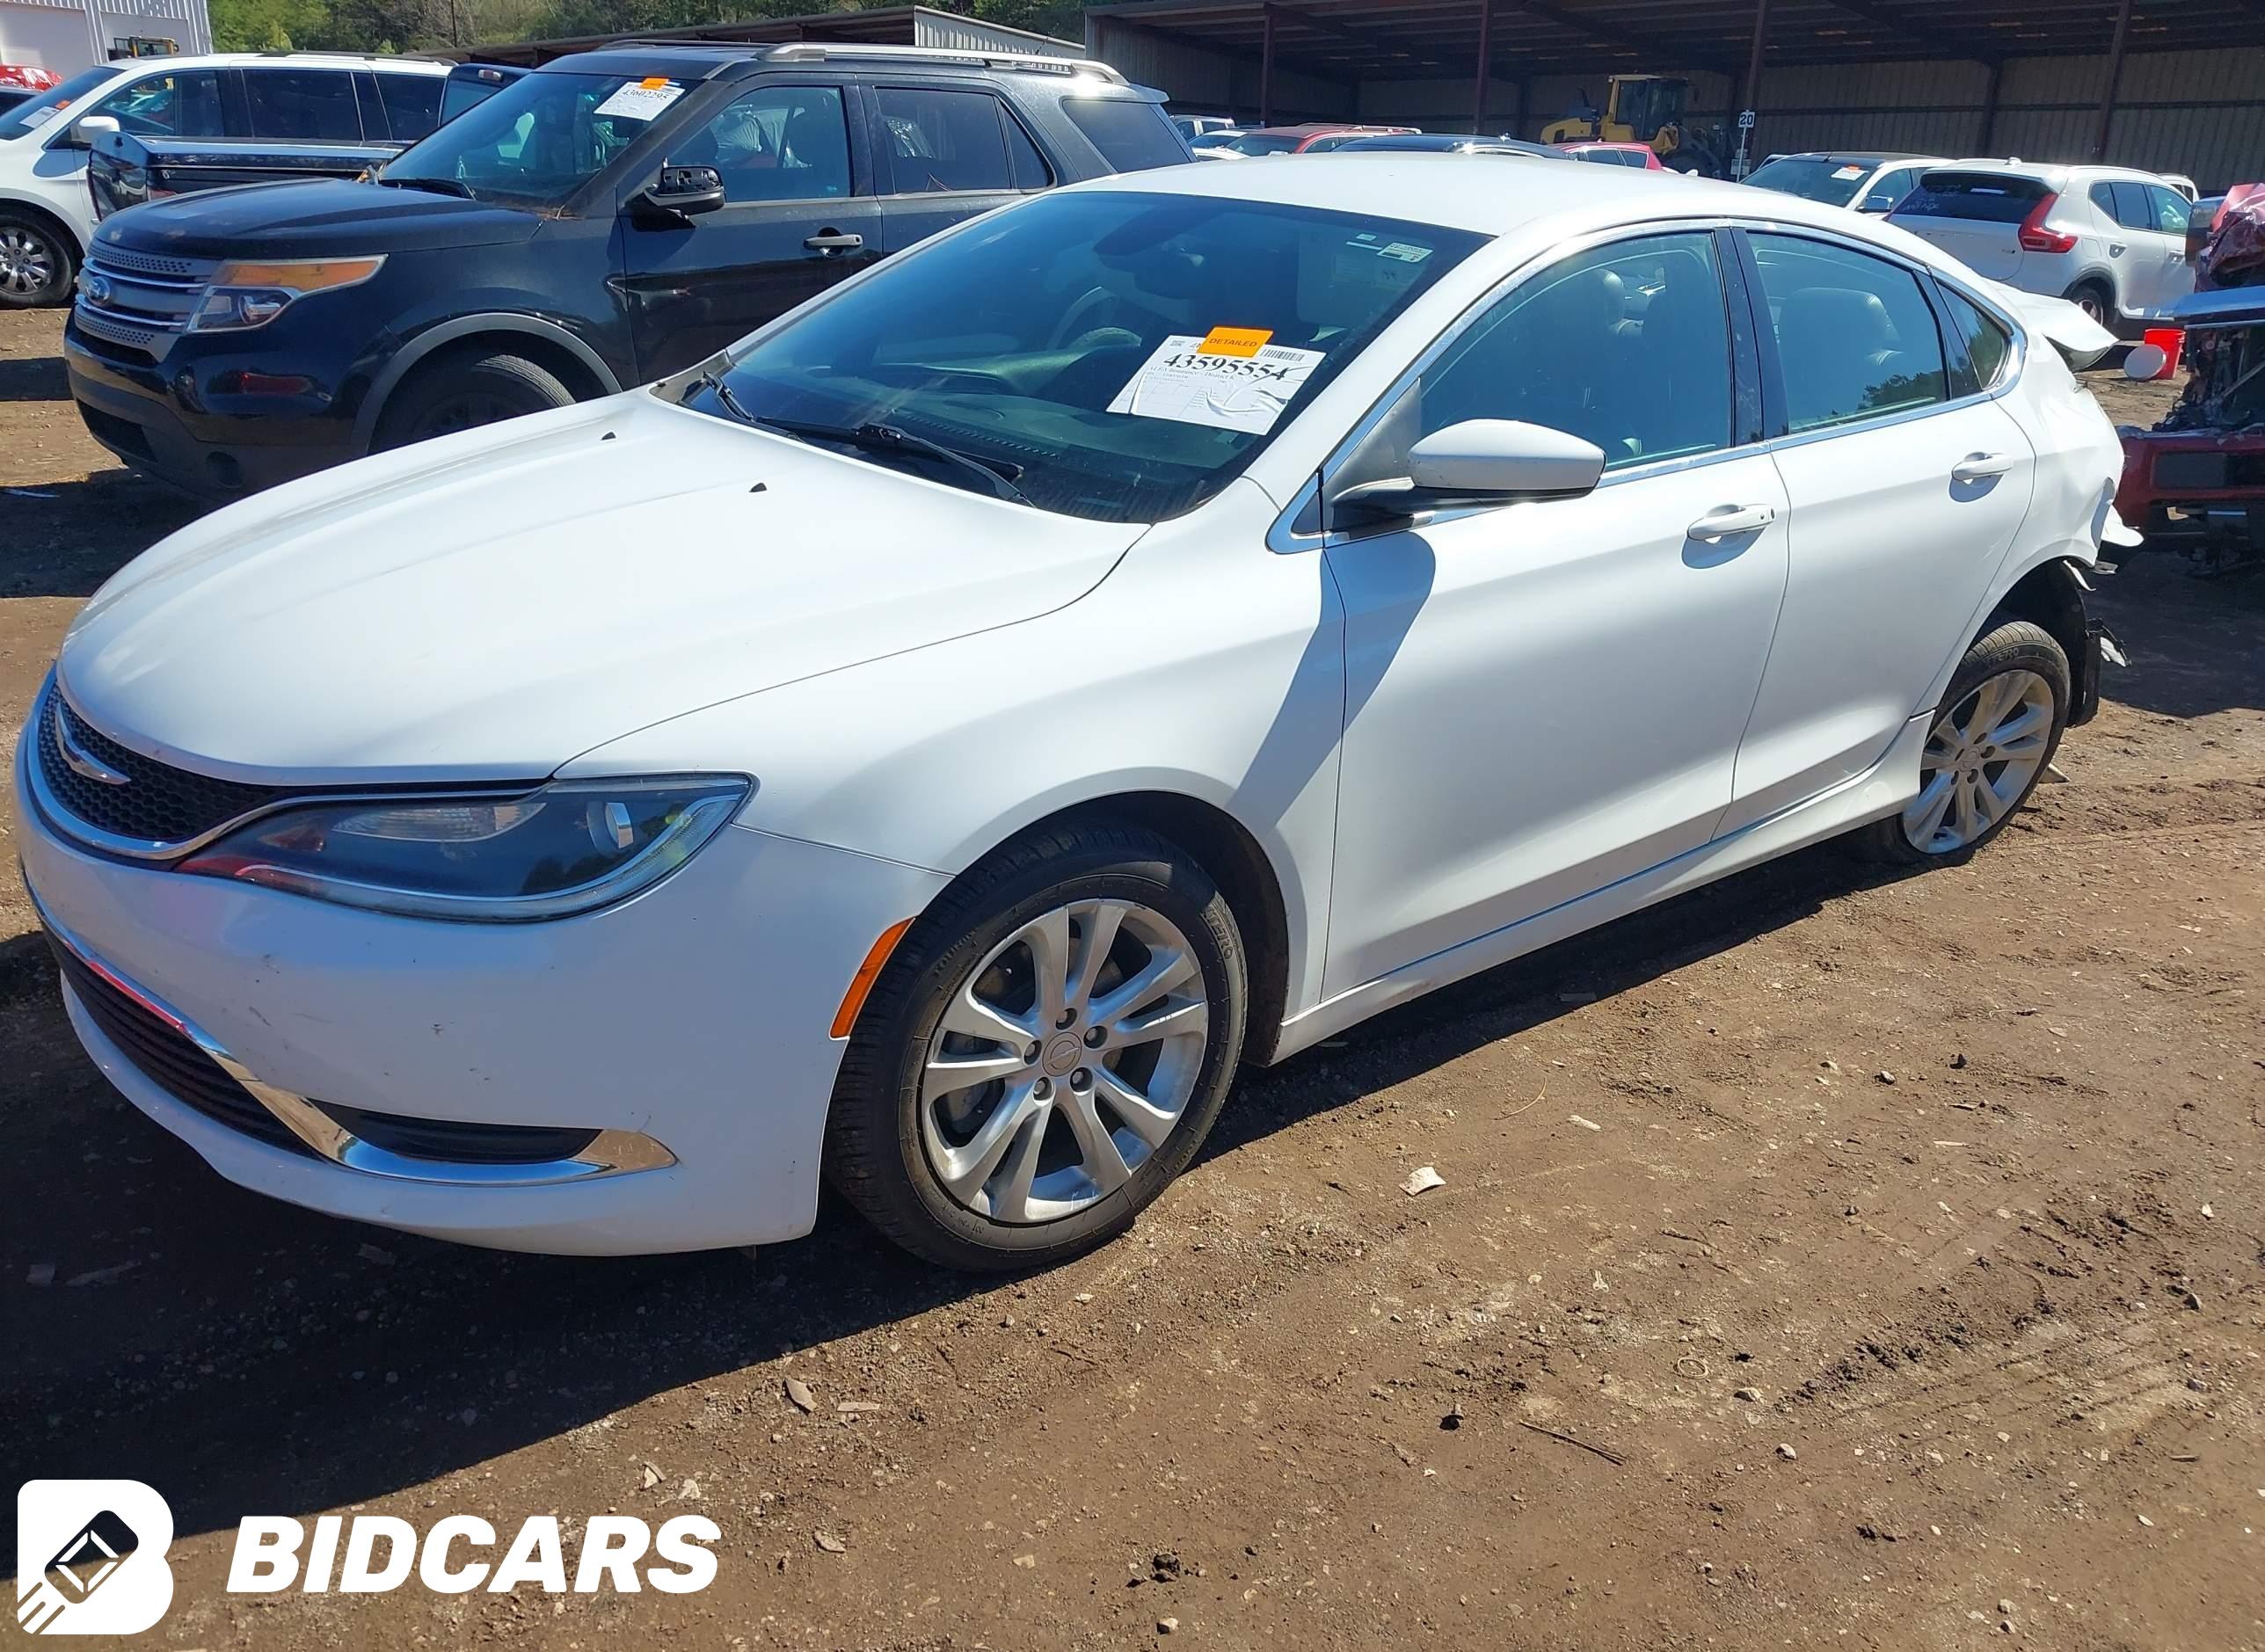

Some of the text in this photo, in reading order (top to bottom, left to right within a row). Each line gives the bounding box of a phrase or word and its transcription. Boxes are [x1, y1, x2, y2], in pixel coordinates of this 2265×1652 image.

[1740, 114, 1753, 125] 20
[1209, 338, 1257, 347] DETAILED
[1162, 353, 1289, 381] 43595554
